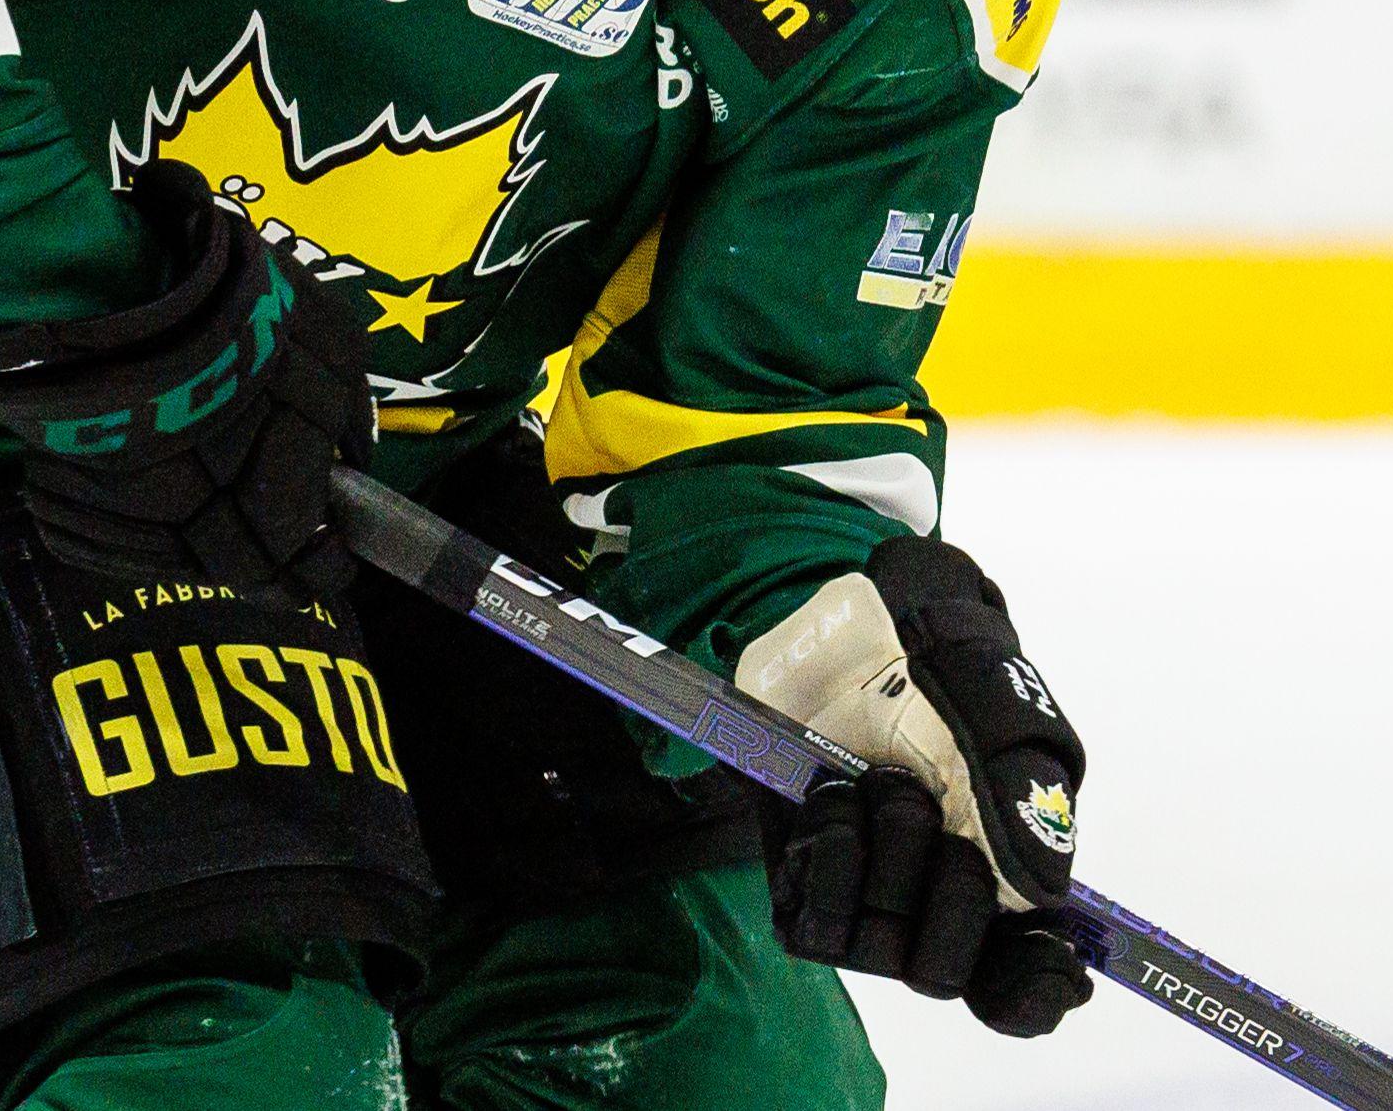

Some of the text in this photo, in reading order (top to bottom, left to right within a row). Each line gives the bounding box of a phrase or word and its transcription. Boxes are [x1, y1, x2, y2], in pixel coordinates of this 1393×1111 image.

[43, 248, 296, 455] CCM
[83, 601, 124, 631] LA
[52, 643, 407, 797] GUSTO
